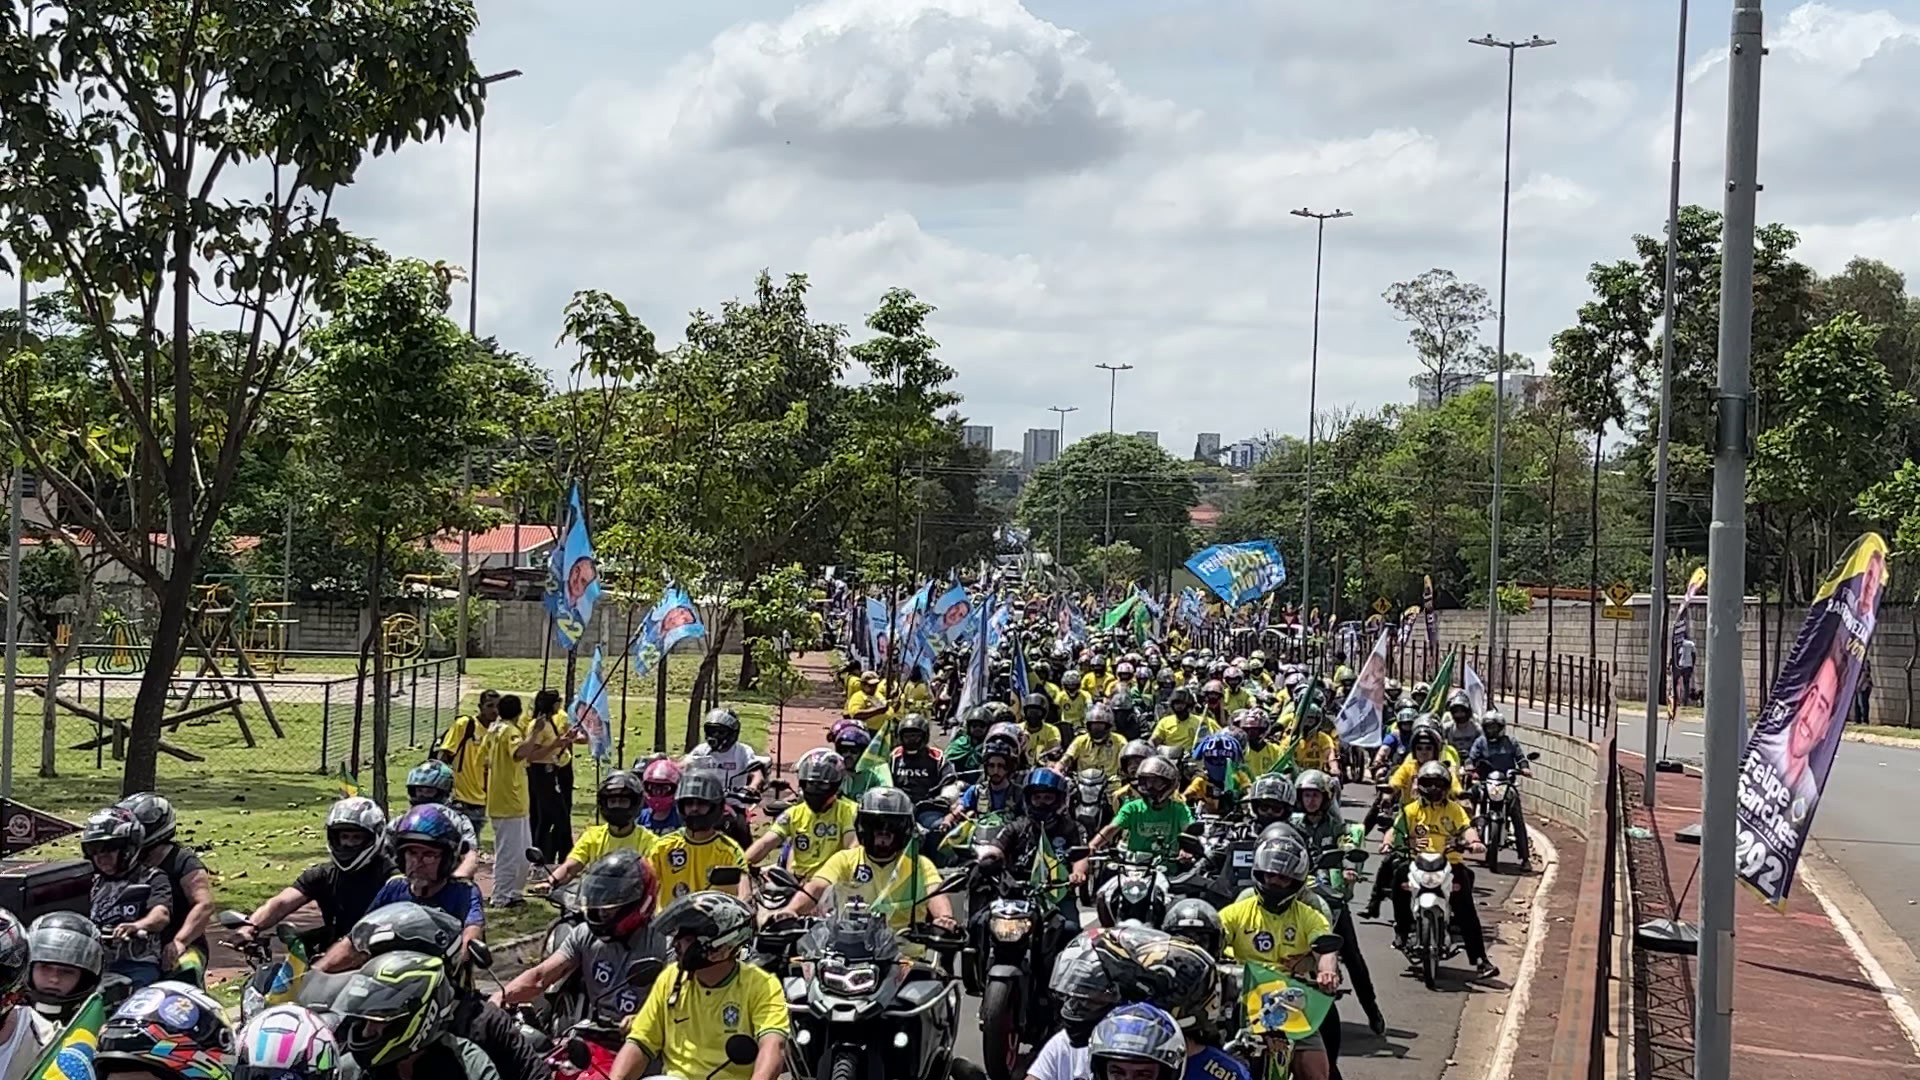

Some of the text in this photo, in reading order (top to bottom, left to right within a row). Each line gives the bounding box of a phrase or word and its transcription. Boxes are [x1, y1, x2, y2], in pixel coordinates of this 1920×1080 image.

[1743, 750, 1790, 807] Felipe
[1737, 774, 1799, 849] Sanches
[672, 855, 685, 866] 10
[123, 904, 136, 916] 10
[1258, 939, 1272, 951] 10
[595, 968, 609, 983] 10
[620, 998, 635, 1013] 10
